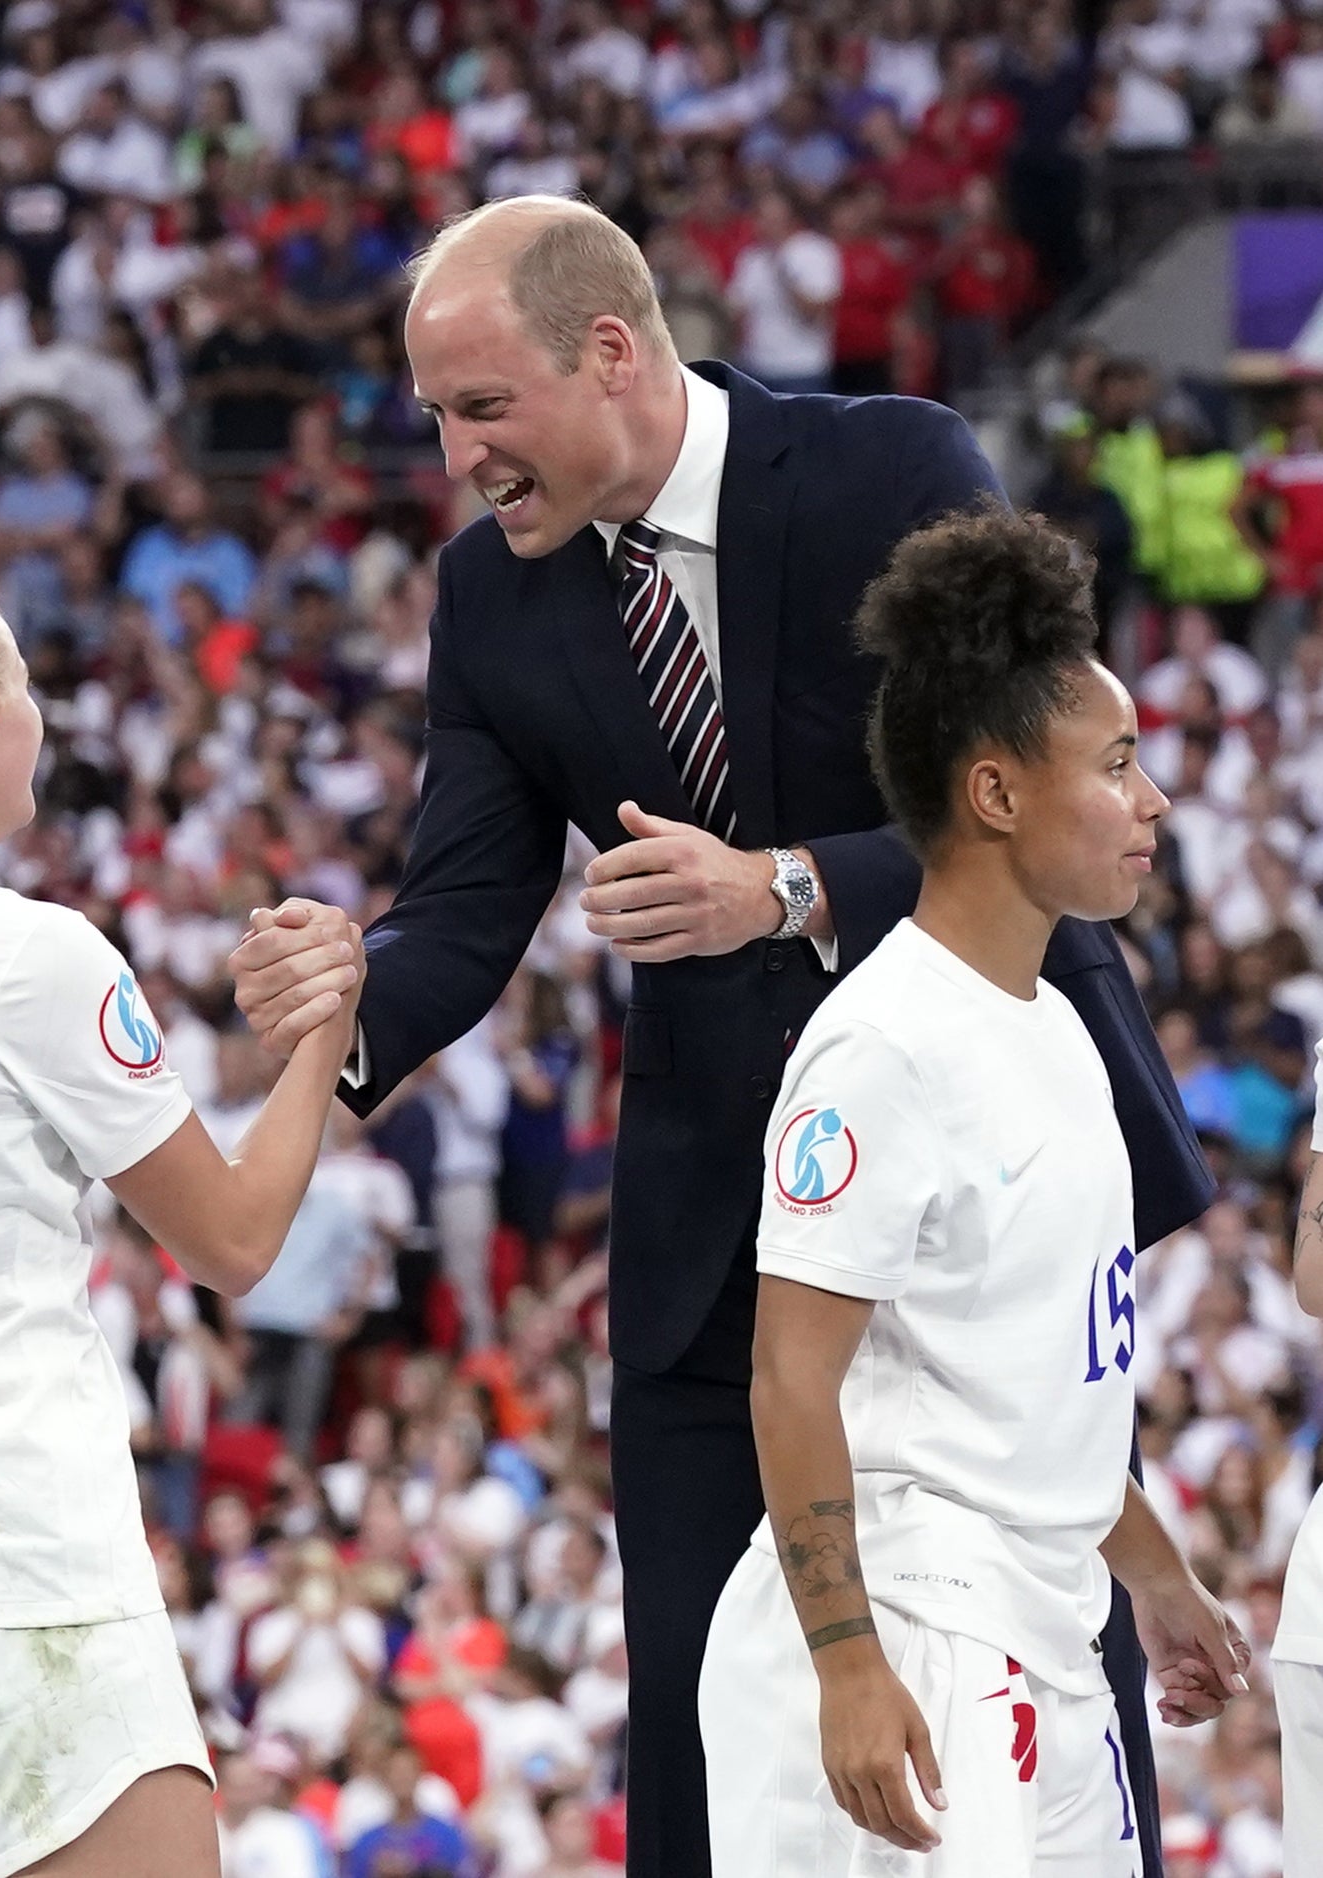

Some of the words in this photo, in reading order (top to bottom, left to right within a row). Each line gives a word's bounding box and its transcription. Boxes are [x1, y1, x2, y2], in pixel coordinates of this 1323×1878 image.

[773, 1191, 807, 1216] ENGLAND
[808, 1203, 834, 1217] 2022
[1083, 1244, 1135, 1384] 15
